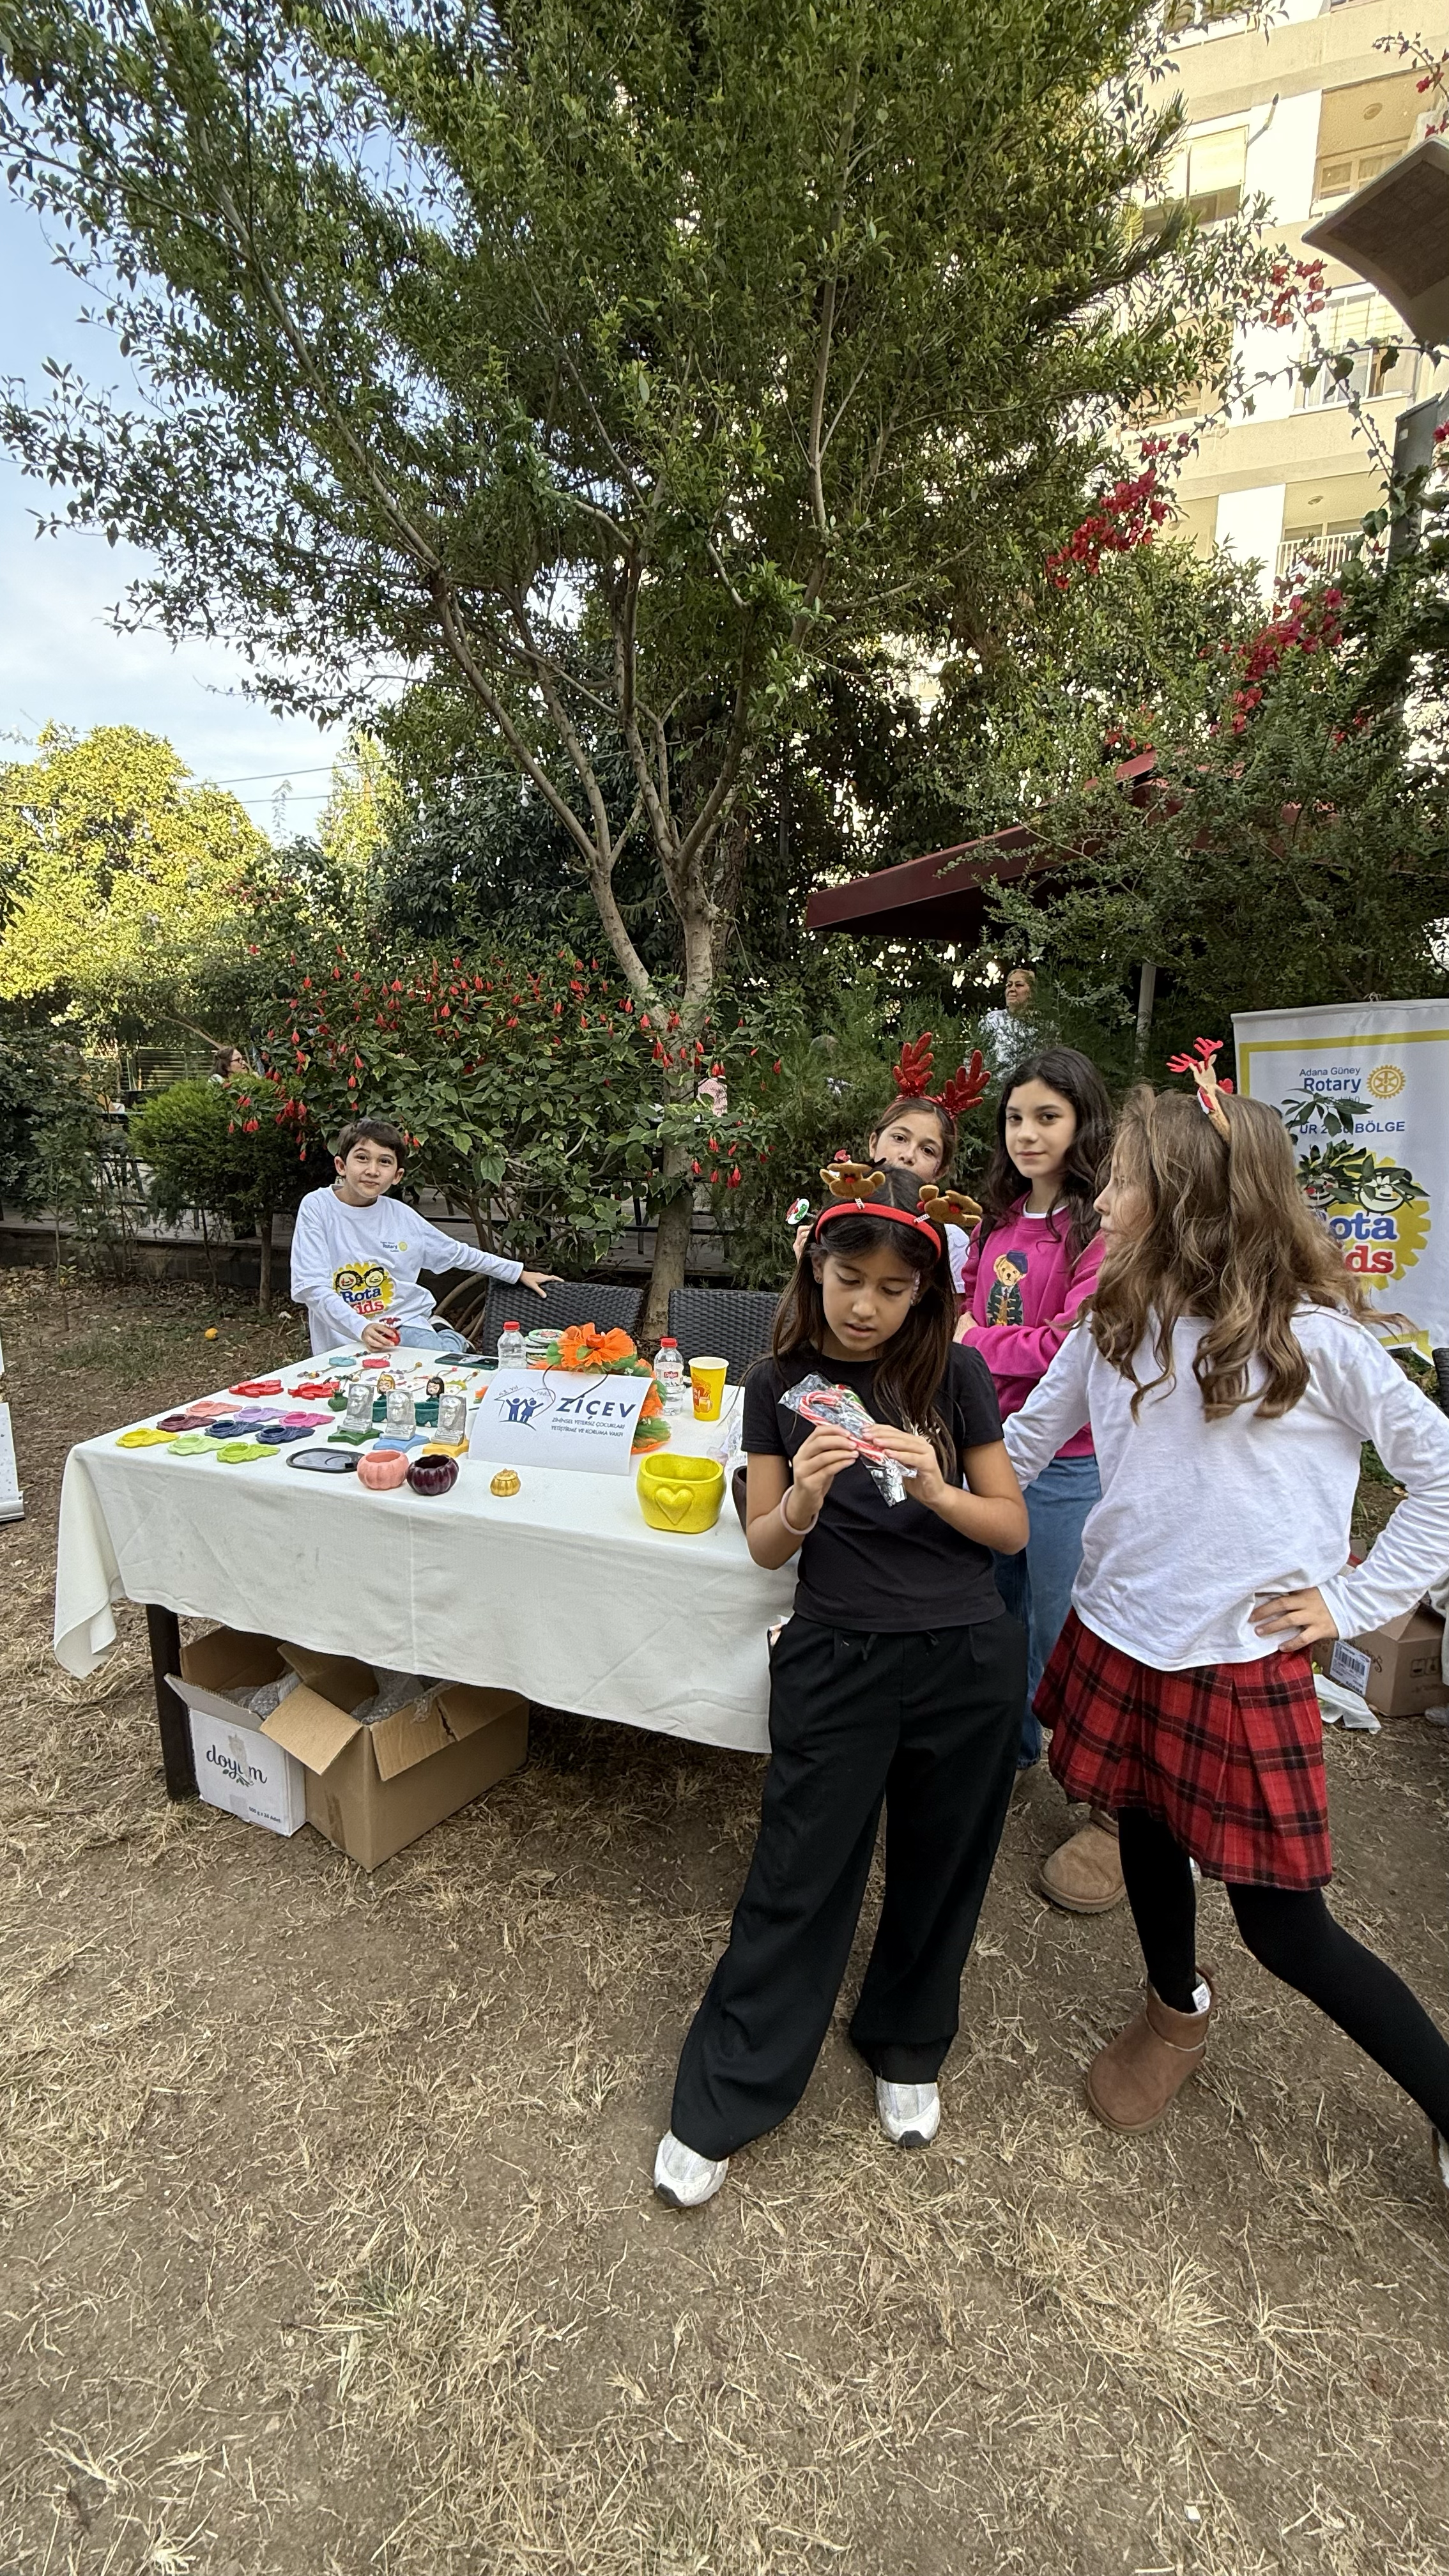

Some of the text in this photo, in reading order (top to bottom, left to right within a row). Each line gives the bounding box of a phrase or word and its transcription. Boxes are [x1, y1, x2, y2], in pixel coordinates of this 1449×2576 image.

[1299, 1066, 1361, 1077] Adana Güney
[1304, 1078, 1361, 1093] Rotary
[1355, 1121, 1406, 1133] BÖLGE
[1322, 1212, 1397, 1240] ota
[340, 1288, 381, 1303] Rota
[556, 1394, 636, 1420] ZİÇEV
